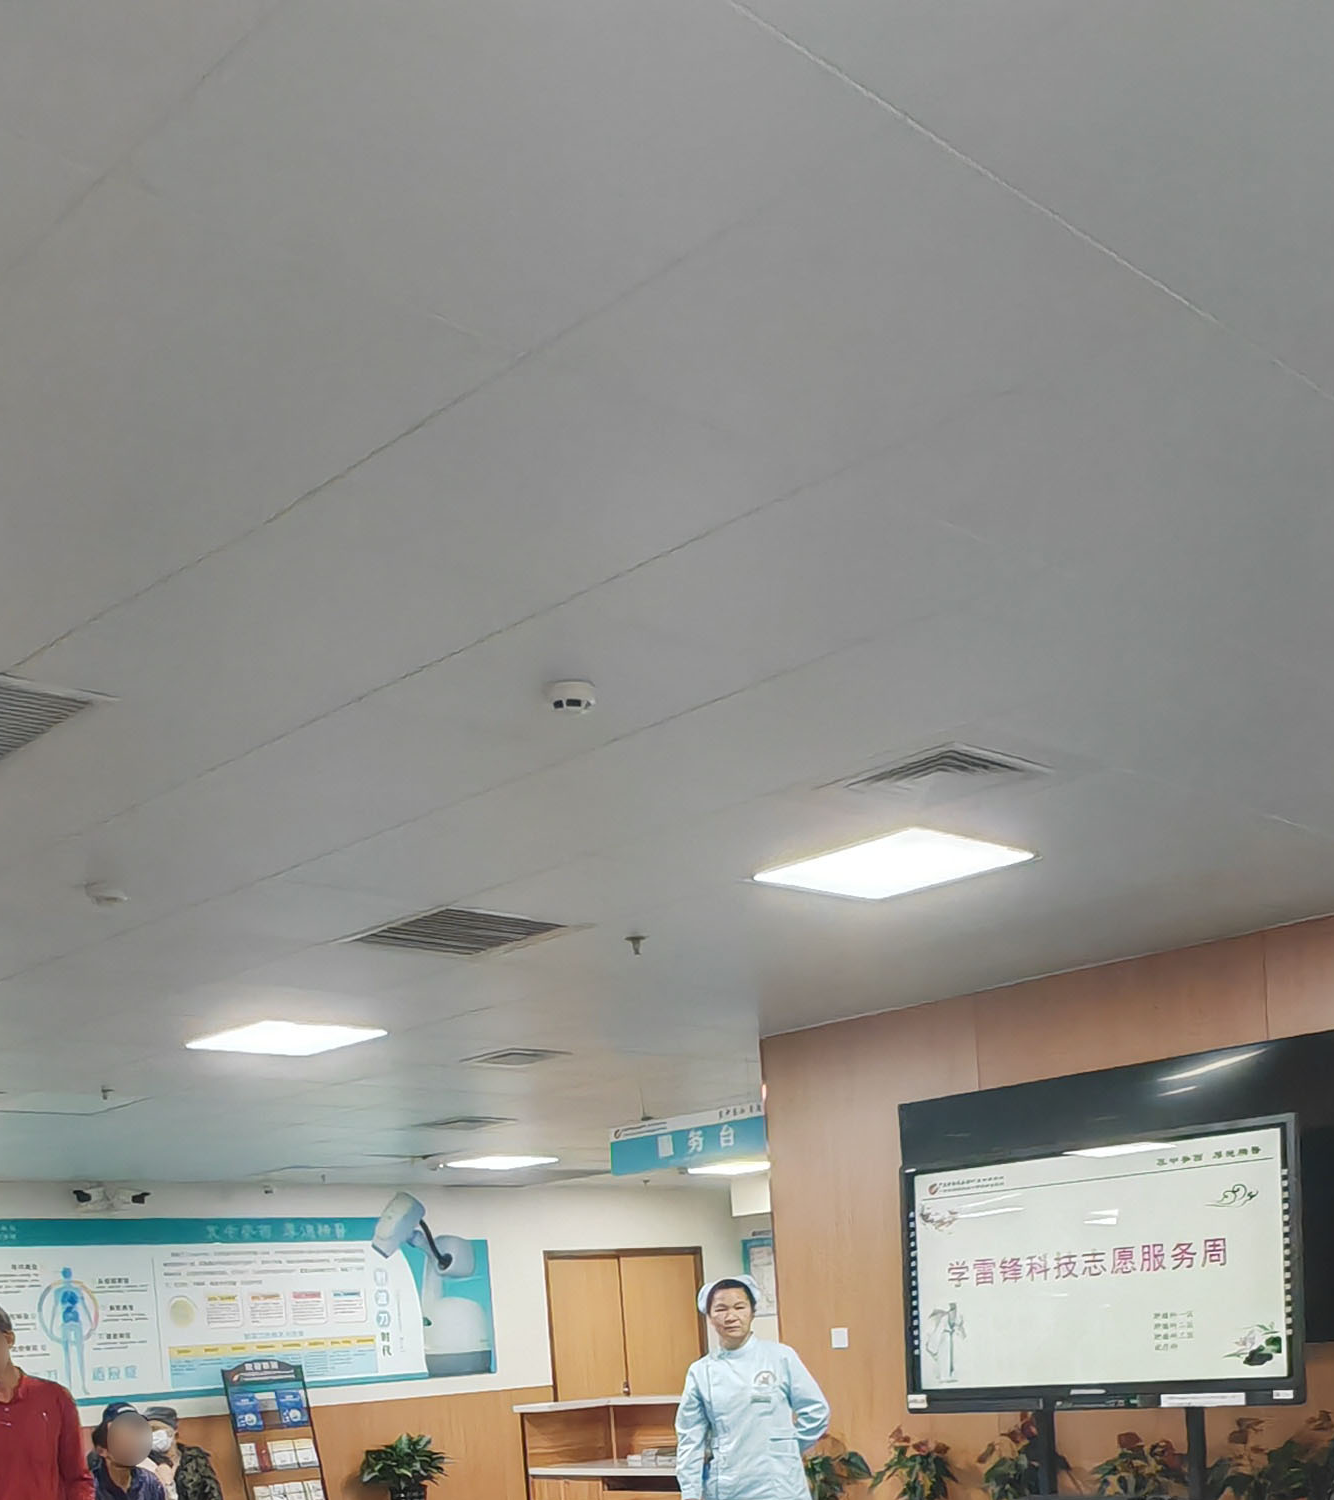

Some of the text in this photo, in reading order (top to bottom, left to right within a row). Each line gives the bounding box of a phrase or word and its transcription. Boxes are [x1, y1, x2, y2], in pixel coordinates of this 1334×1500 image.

[946, 1236, 1228, 1288] 学雷锋科技志愿服务周
